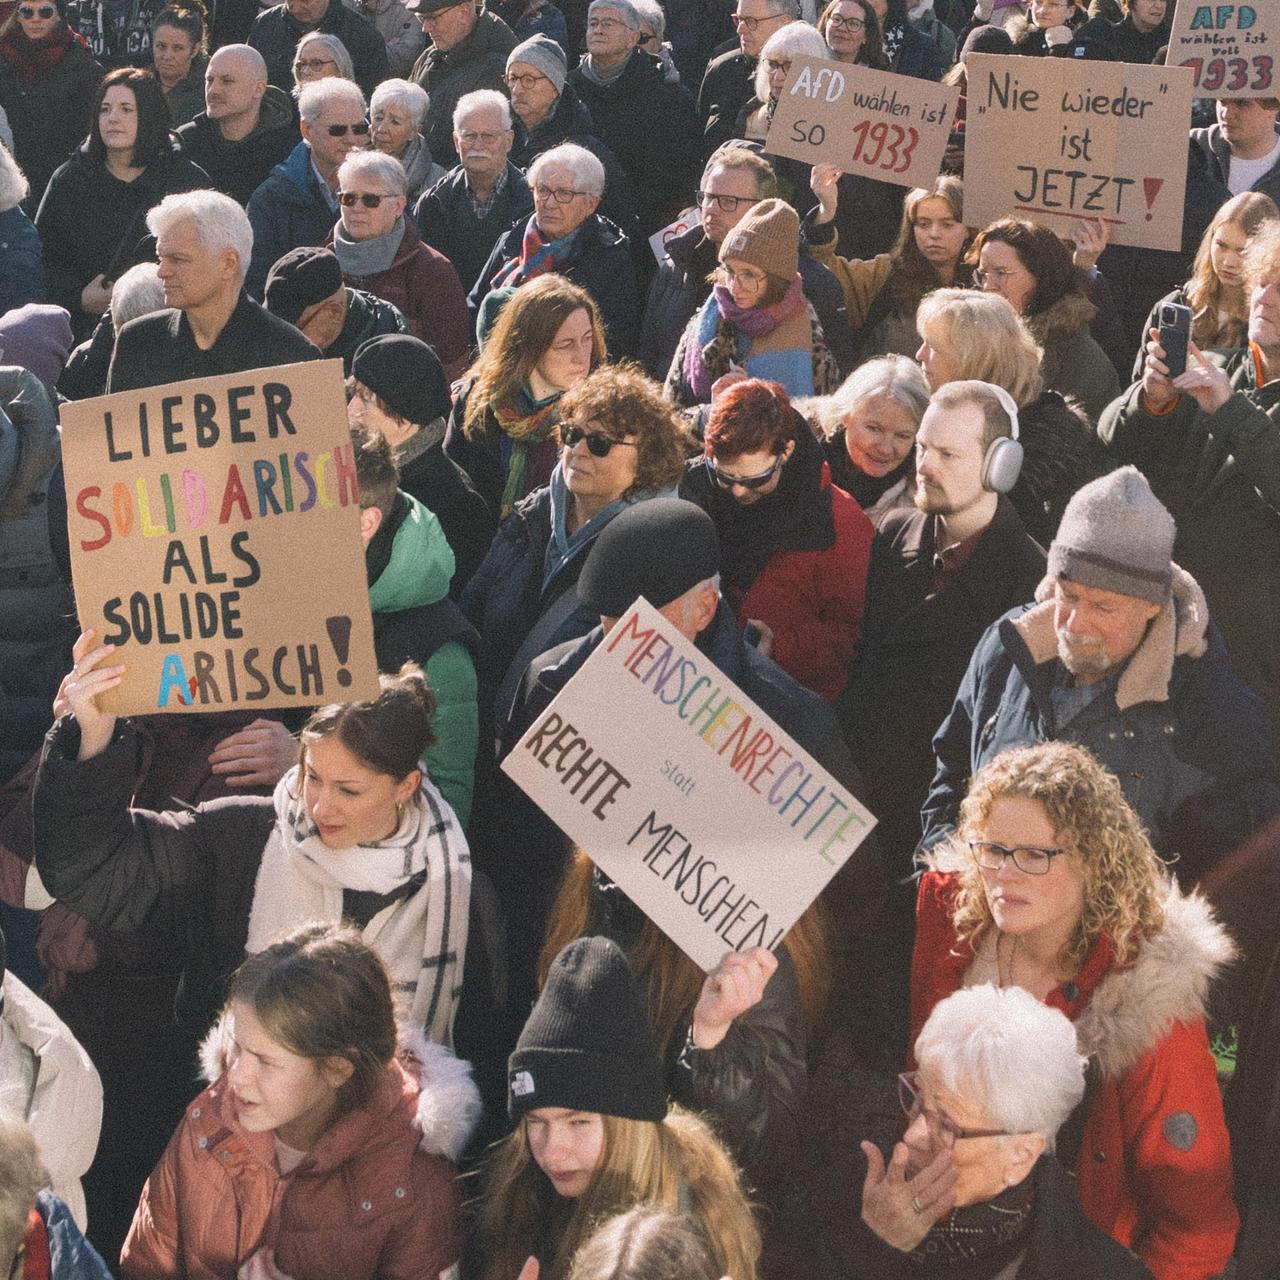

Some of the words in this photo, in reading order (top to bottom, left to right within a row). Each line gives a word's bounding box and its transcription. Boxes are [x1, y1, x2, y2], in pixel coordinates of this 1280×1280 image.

[1180, 33, 1236, 44] wählen
[1244, 32, 1268, 43] ist
[1189, 5, 1257, 30] AFD
[1178, 55, 1274, 91] 1933
[1212, 47, 1240, 57] voll
[790, 66, 846, 102] AfD
[853, 85, 910, 117] wählen
[921, 103, 948, 125] ist
[852, 120, 919, 173] 1933
[1061, 125, 1092, 161] ist
[104, 382, 297, 463] LIEBER
[76, 442, 360, 552] SOLIDARISCH
[162, 531, 261, 588] ALS
[103, 591, 243, 647] SOLIDE
[607, 612, 867, 865] MENSCHENRECHTE
[525, 713, 632, 821] RECHTE
[627, 810, 784, 953] MENSCHEN
